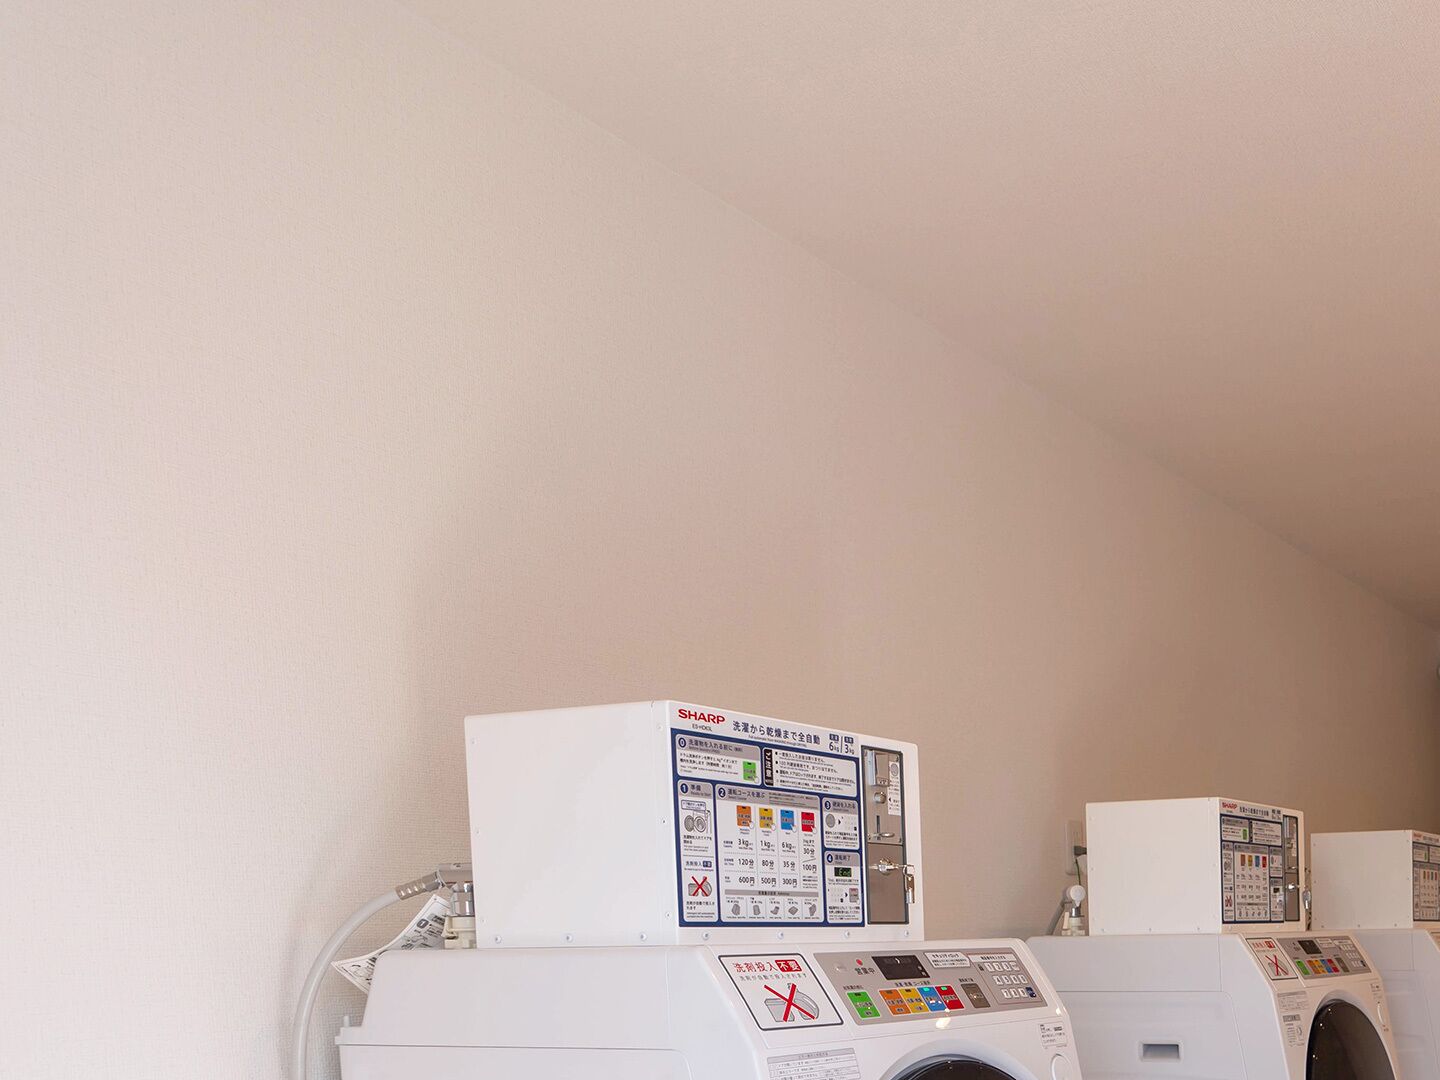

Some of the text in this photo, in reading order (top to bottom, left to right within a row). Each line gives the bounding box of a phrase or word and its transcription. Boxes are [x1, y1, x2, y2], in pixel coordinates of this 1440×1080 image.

[678, 708, 726, 725] SHARP
[733, 720, 820, 745] 洗濯から乾燥まで全自動
